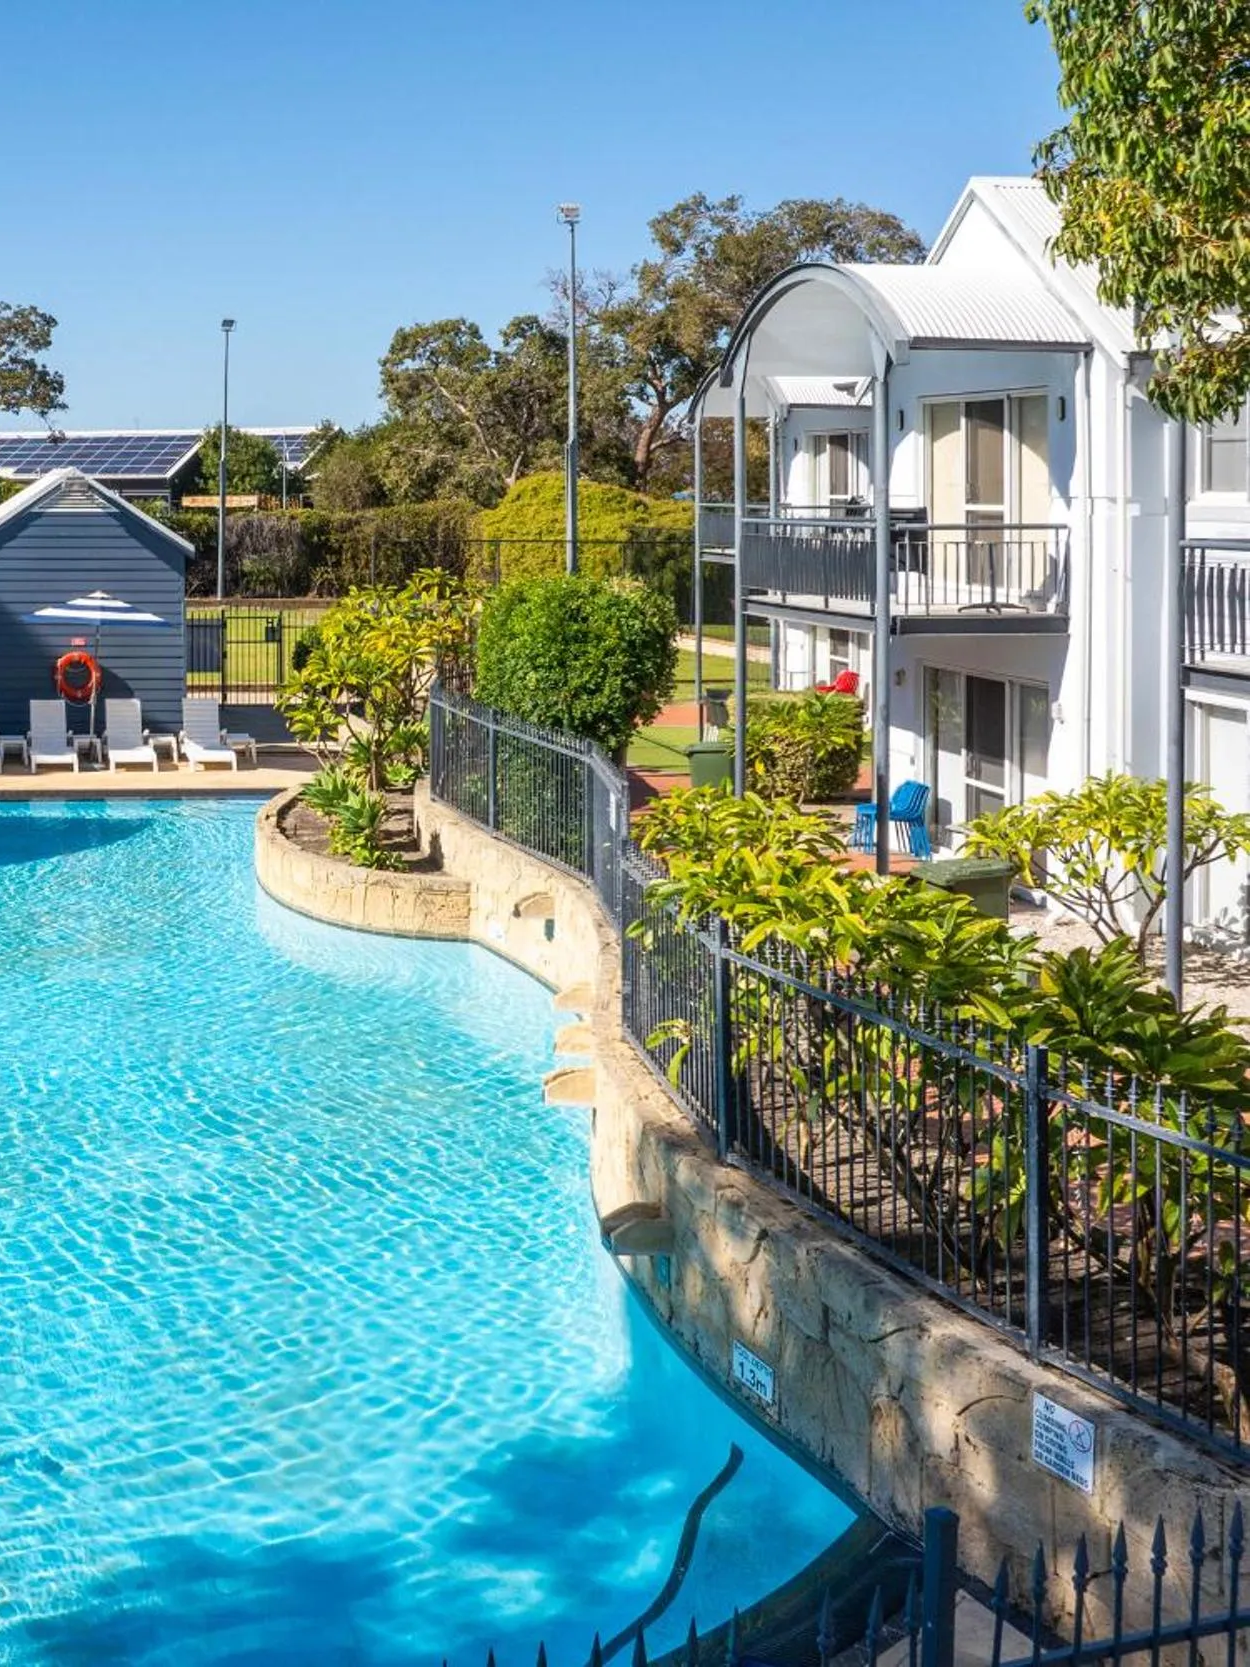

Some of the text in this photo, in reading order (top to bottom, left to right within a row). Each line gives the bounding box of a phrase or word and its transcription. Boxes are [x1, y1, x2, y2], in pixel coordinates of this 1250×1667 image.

[739, 1362, 768, 1397] 1.3m
[1044, 1400, 1056, 1415] NO
[1071, 1471, 1088, 1488] BEDS
